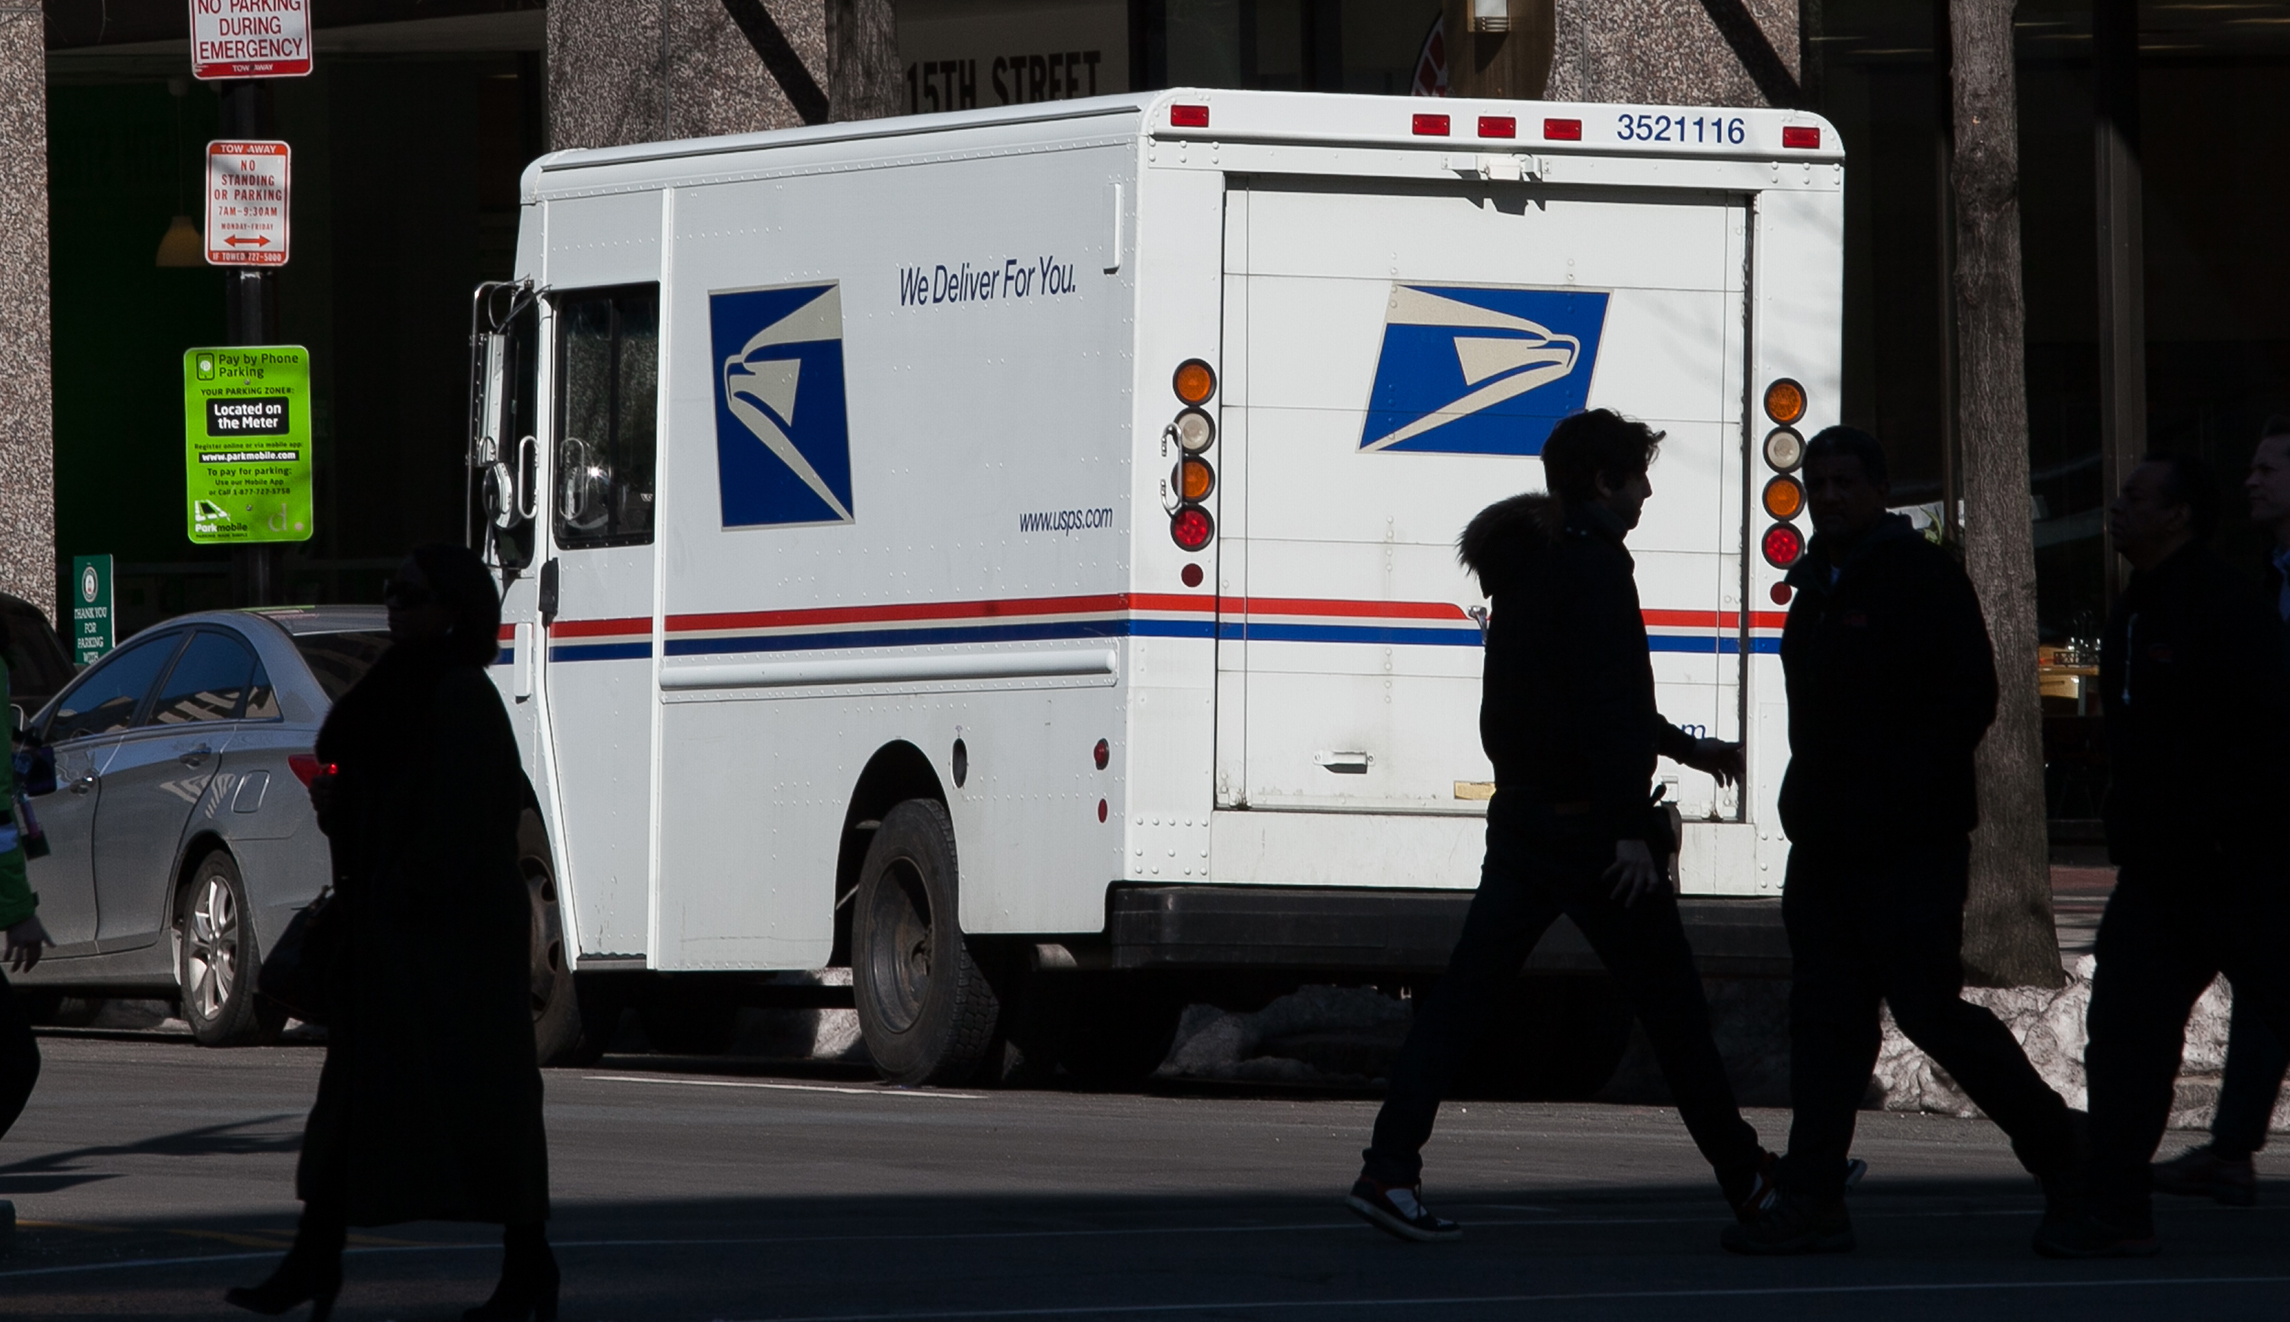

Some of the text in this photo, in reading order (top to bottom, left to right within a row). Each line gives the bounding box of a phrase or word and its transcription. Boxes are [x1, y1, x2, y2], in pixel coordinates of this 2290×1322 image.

[198, 0, 301, 14] NO PARKING
[219, 16, 281, 36] DURING
[200, 38, 302, 59] EMERGENCY
[232, 63, 274, 72] TOW AWAY
[906, 50, 1101, 114] 15TH STREET
[1616, 114, 1745, 144] 3521116
[220, 144, 277, 154] TOW AWAY
[241, 160, 256, 171] NO
[221, 174, 275, 186] STANDING
[214, 189, 282, 201] OR PARKING
[212, 252, 220, 261] IF
[222, 252, 246, 261] TOWED
[900, 255, 1076, 306] We Deliver For You.
[219, 353, 299, 366] Pay by Phone
[219, 366, 264, 379] Parking
[201, 388, 223, 396] YOUR
[225, 387, 262, 395] PARKING
[214, 402, 281, 416] Located on
[218, 417, 279, 429] the Meter
[194, 443, 222, 451] Register
[202, 451, 296, 462] www.parkmobile.com
[207, 466, 292, 477] To pay for parking:
[244, 478, 268, 486] Mobile
[269, 478, 284, 486] App
[195, 522, 248, 533] Parkmobile
[1020, 507, 1113, 537] www.usps.com
[74, 606, 107, 619] THANK YOU
[84, 622, 97, 634] FOR
[77, 636, 104, 649] PARKING
